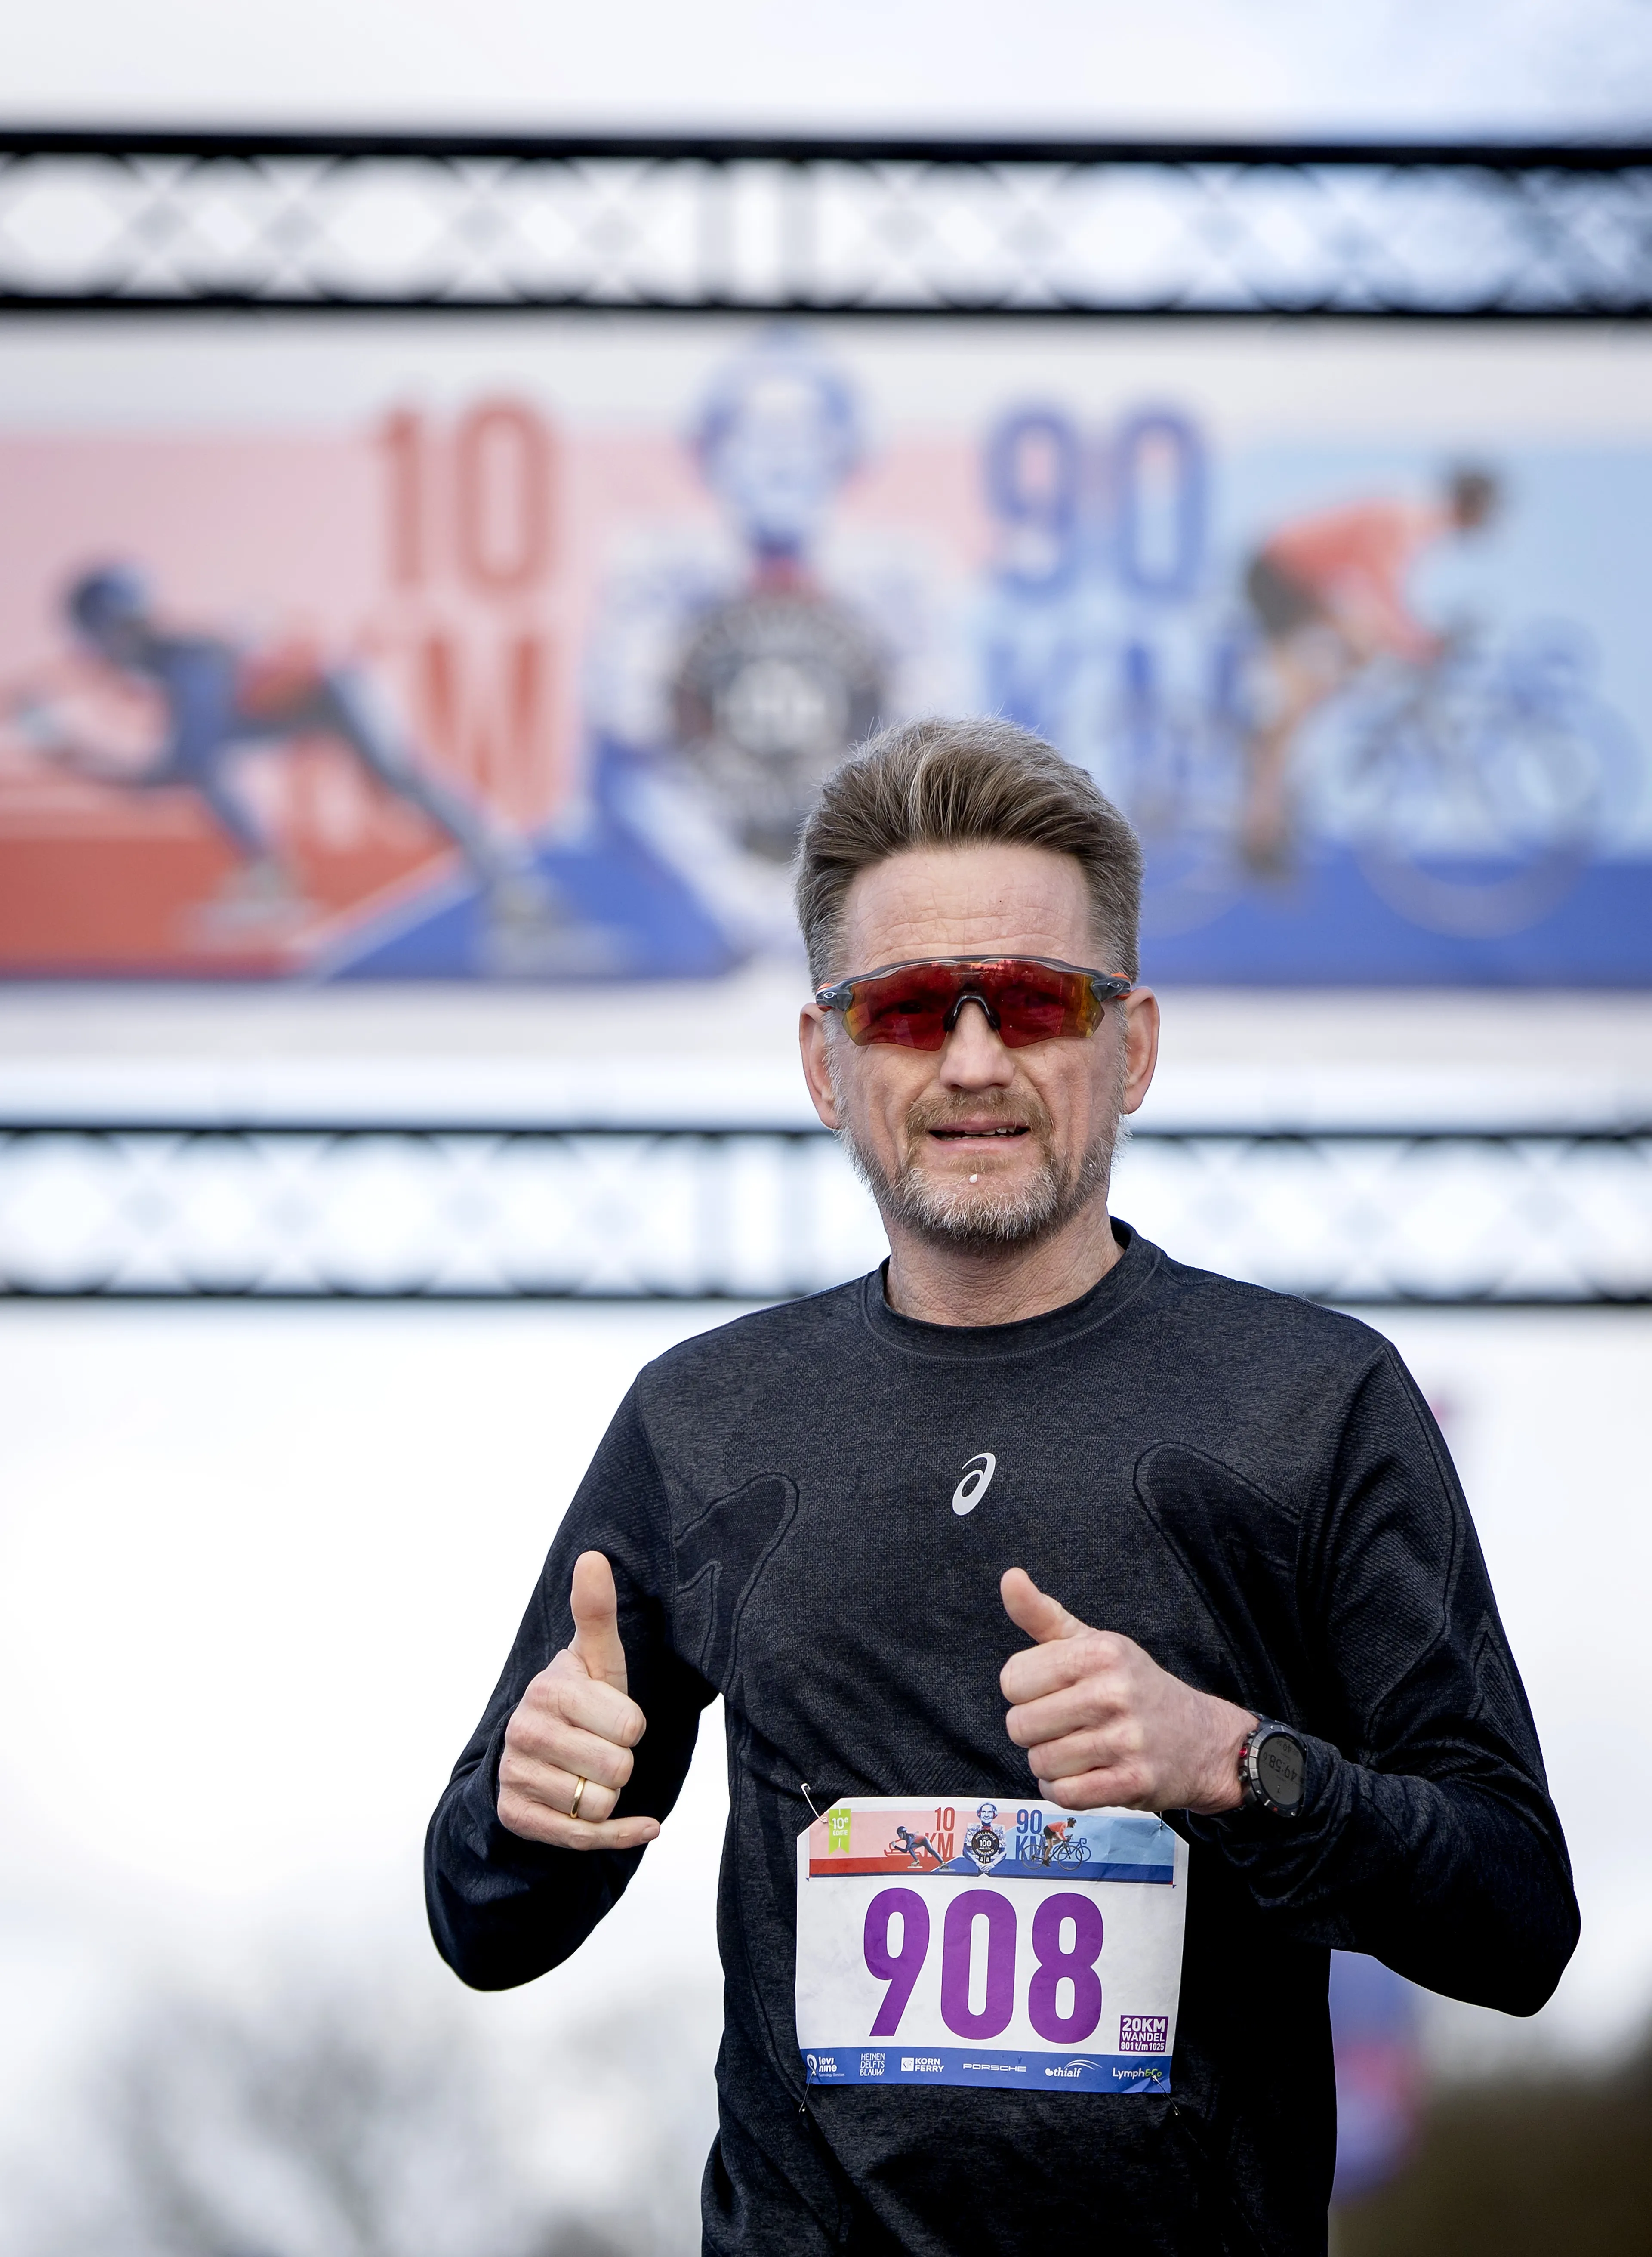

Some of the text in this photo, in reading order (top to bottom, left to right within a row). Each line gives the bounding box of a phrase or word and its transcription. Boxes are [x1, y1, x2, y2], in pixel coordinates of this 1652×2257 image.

[370, 400, 557, 596] 10
[989, 396, 1209, 600] 90
[934, 1807, 955, 1831] 10
[1016, 1809, 1042, 1834] 90
[863, 1887, 1103, 2044] 908
[1122, 2017, 1165, 2032] 20KM
[1121, 2032, 1165, 2042] WANDEL
[1121, 2041, 1165, 2051] 801 t/m 1025
[818, 2056, 834, 2065] levi
[963, 2063, 1027, 2072] PORSCHE
[1053, 2067, 1082, 2078] thialf
[1112, 2067, 1162, 2080] Lymph&Co
